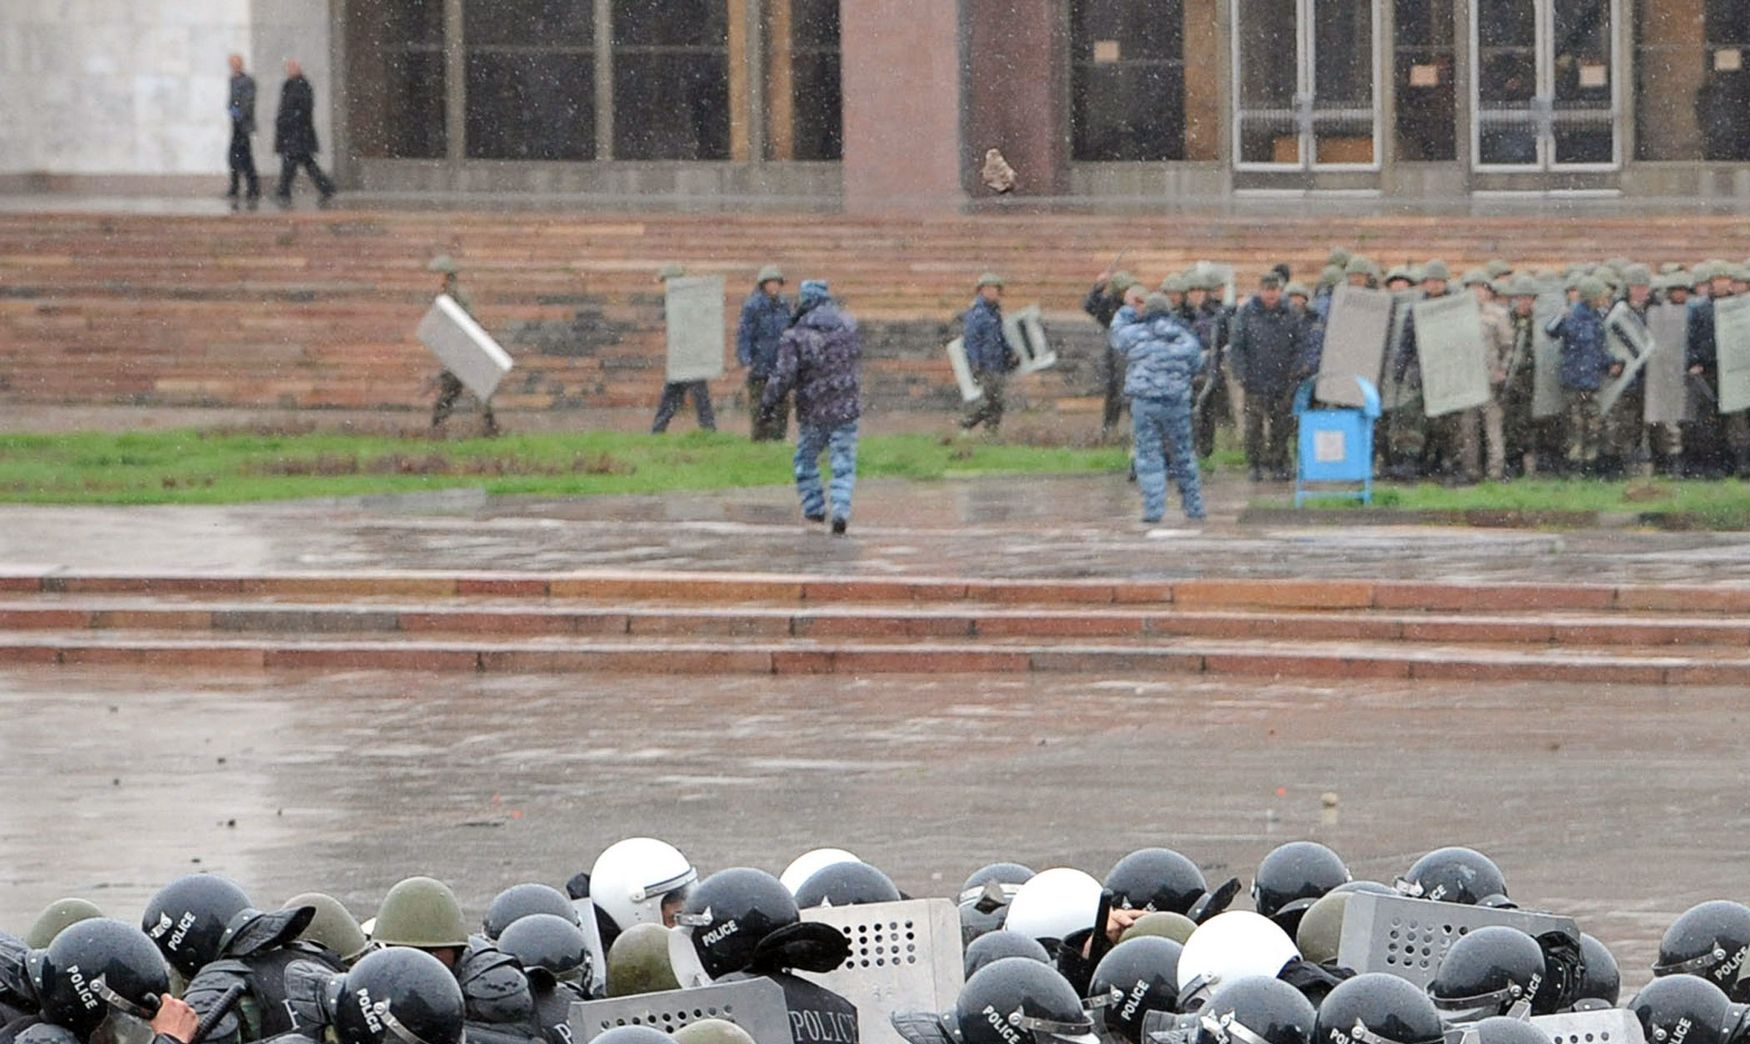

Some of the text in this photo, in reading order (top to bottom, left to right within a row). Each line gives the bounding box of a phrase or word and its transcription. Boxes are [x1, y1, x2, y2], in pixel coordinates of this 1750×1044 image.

[167, 911, 196, 951] POLICE
[701, 919, 739, 947] POLICE
[66, 965, 98, 1010] POLICE
[1120, 979, 1150, 1021] POLICE
[356, 988, 382, 1034] POLICE
